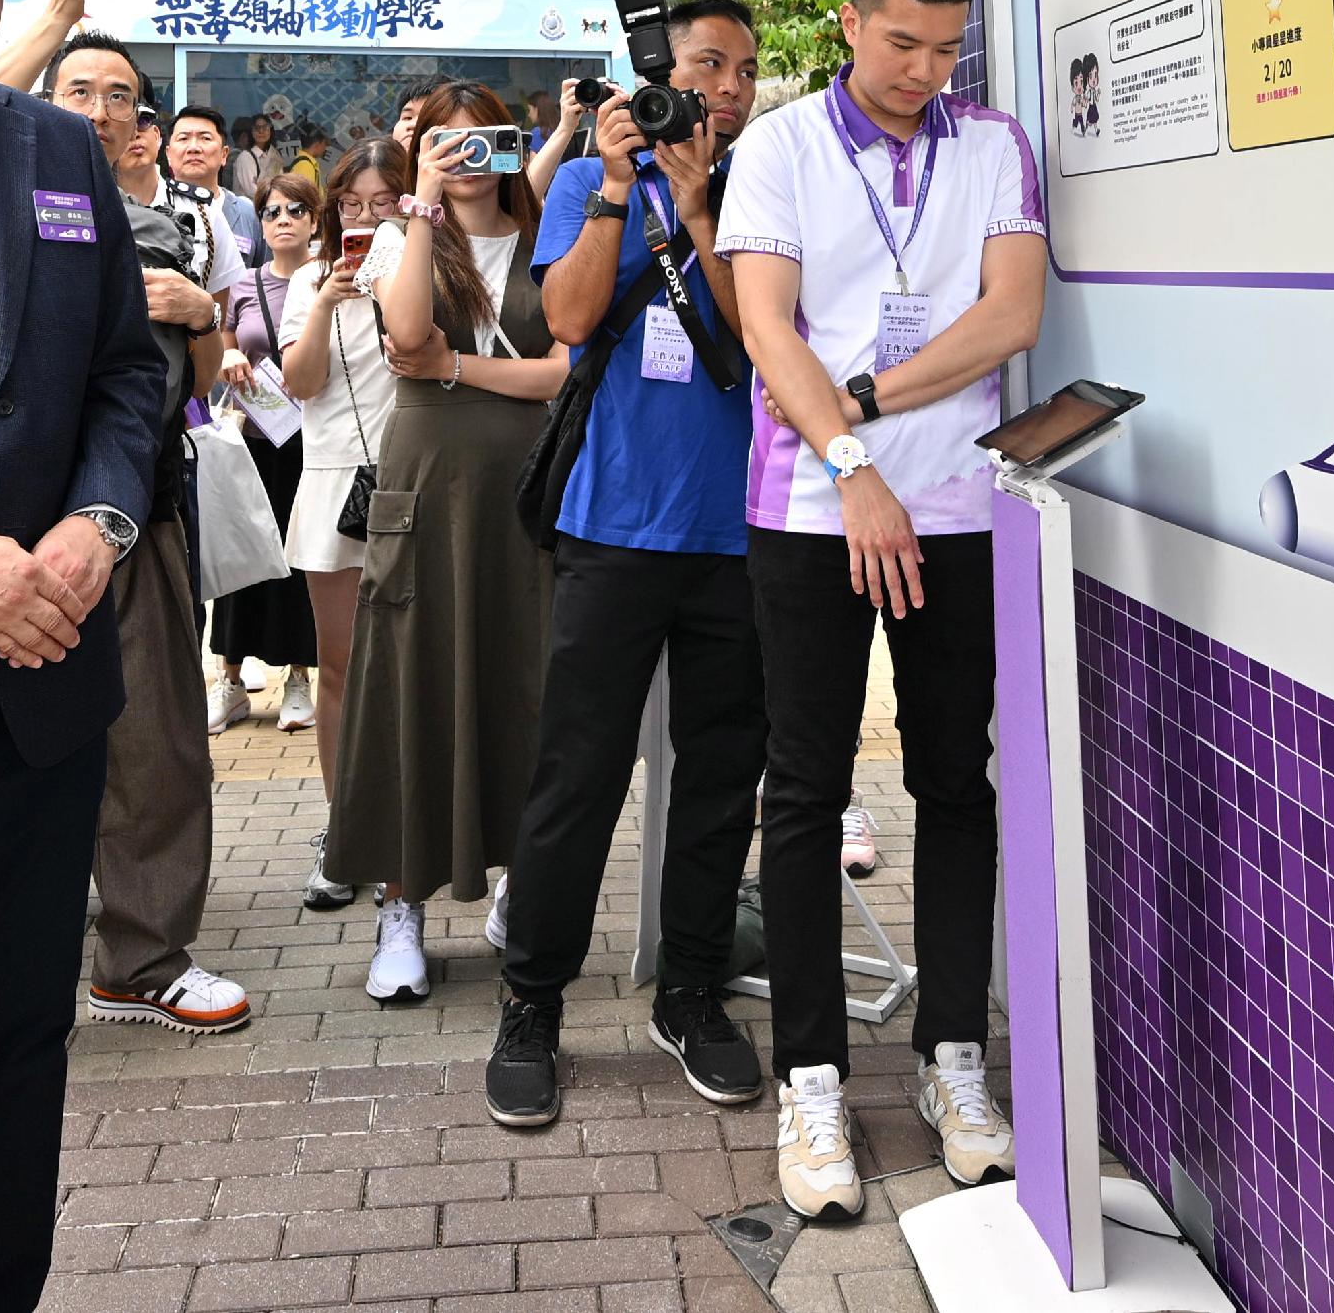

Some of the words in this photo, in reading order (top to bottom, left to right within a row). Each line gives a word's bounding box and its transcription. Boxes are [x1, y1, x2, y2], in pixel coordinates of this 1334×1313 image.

[1263, 64, 1271, 83] 2
[1278, 59, 1293, 79] 20
[658, 254, 689, 306] SONY
[651, 350, 686, 363] 工作人員
[651, 362, 683, 372] STAFF
